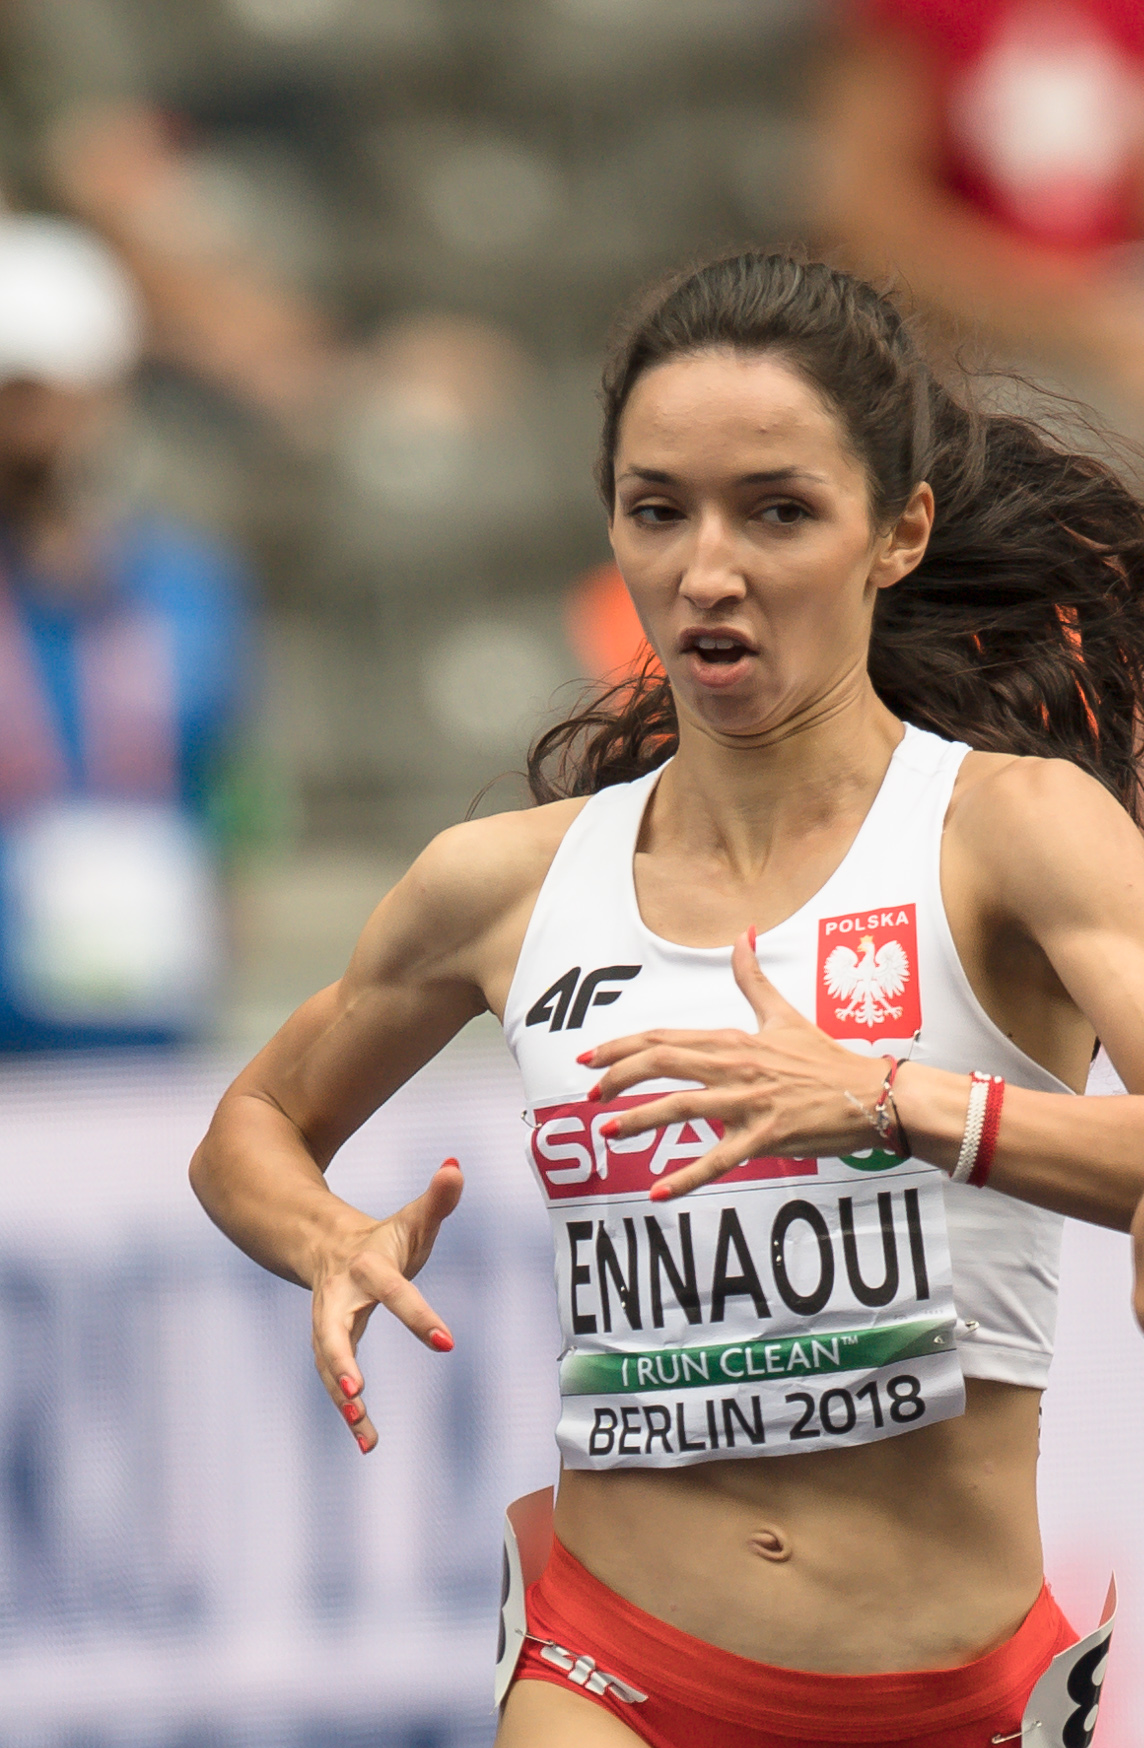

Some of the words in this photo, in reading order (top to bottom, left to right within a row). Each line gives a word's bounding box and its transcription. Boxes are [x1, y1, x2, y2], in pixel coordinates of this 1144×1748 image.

[825, 911, 910, 935] POLSKA
[526, 965, 643, 1032] 4F
[535, 1109, 806, 1185] SPA
[566, 1188, 930, 1335] ENNAOUI
[621, 1358, 630, 1387] I
[638, 1353, 709, 1385] RUN
[588, 1395, 765, 1457] BERLIN
[785, 1374, 926, 1440] 2018
